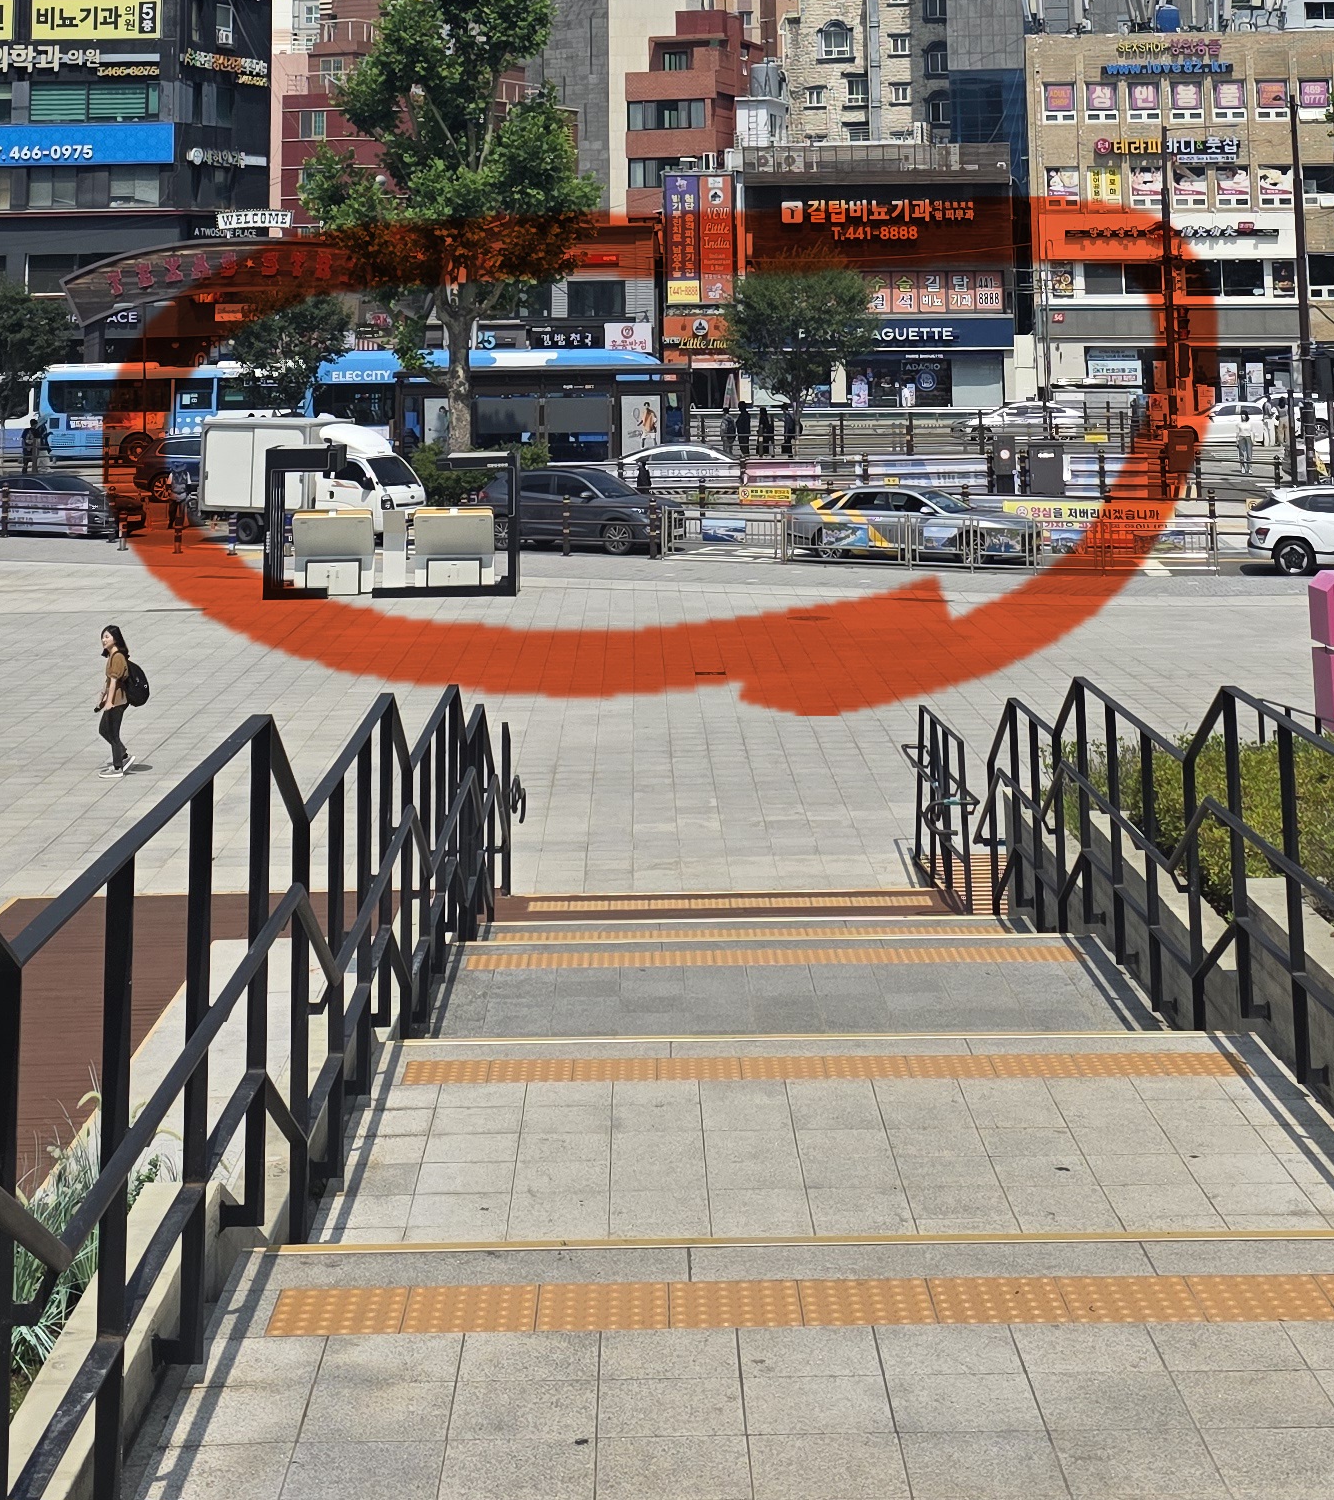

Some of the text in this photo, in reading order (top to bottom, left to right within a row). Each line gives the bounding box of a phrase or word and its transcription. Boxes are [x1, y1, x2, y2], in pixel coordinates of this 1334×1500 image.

[34, 6, 121, 30] 비뇨기과
[123, 6, 135, 32] 의원
[1117, 41, 1167, 54] SEXSHOP
[67, 49, 99, 68] 의원
[1105, 60, 1229, 76] www.love82.kr
[1091, 84, 1243, 108] 성인용품
[1113, 136, 1162, 154] 테라피
[221, 211, 288, 227] WELCOME
[703, 206, 730, 220] NEW
[807, 199, 933, 223] 길탑비뇨기과
[703, 222, 730, 234] Little
[703, 236, 731, 250] India
[105, 252, 237, 297] TEXAS
[925, 275, 970, 292] 길탑
[978, 292, 1001, 305] 8888
[871, 328, 954, 340] AGUETTE
[331, 370, 391, 382] ELEC CITY
[1030, 506, 1160, 521] 양심을 저버리시겠습니까
